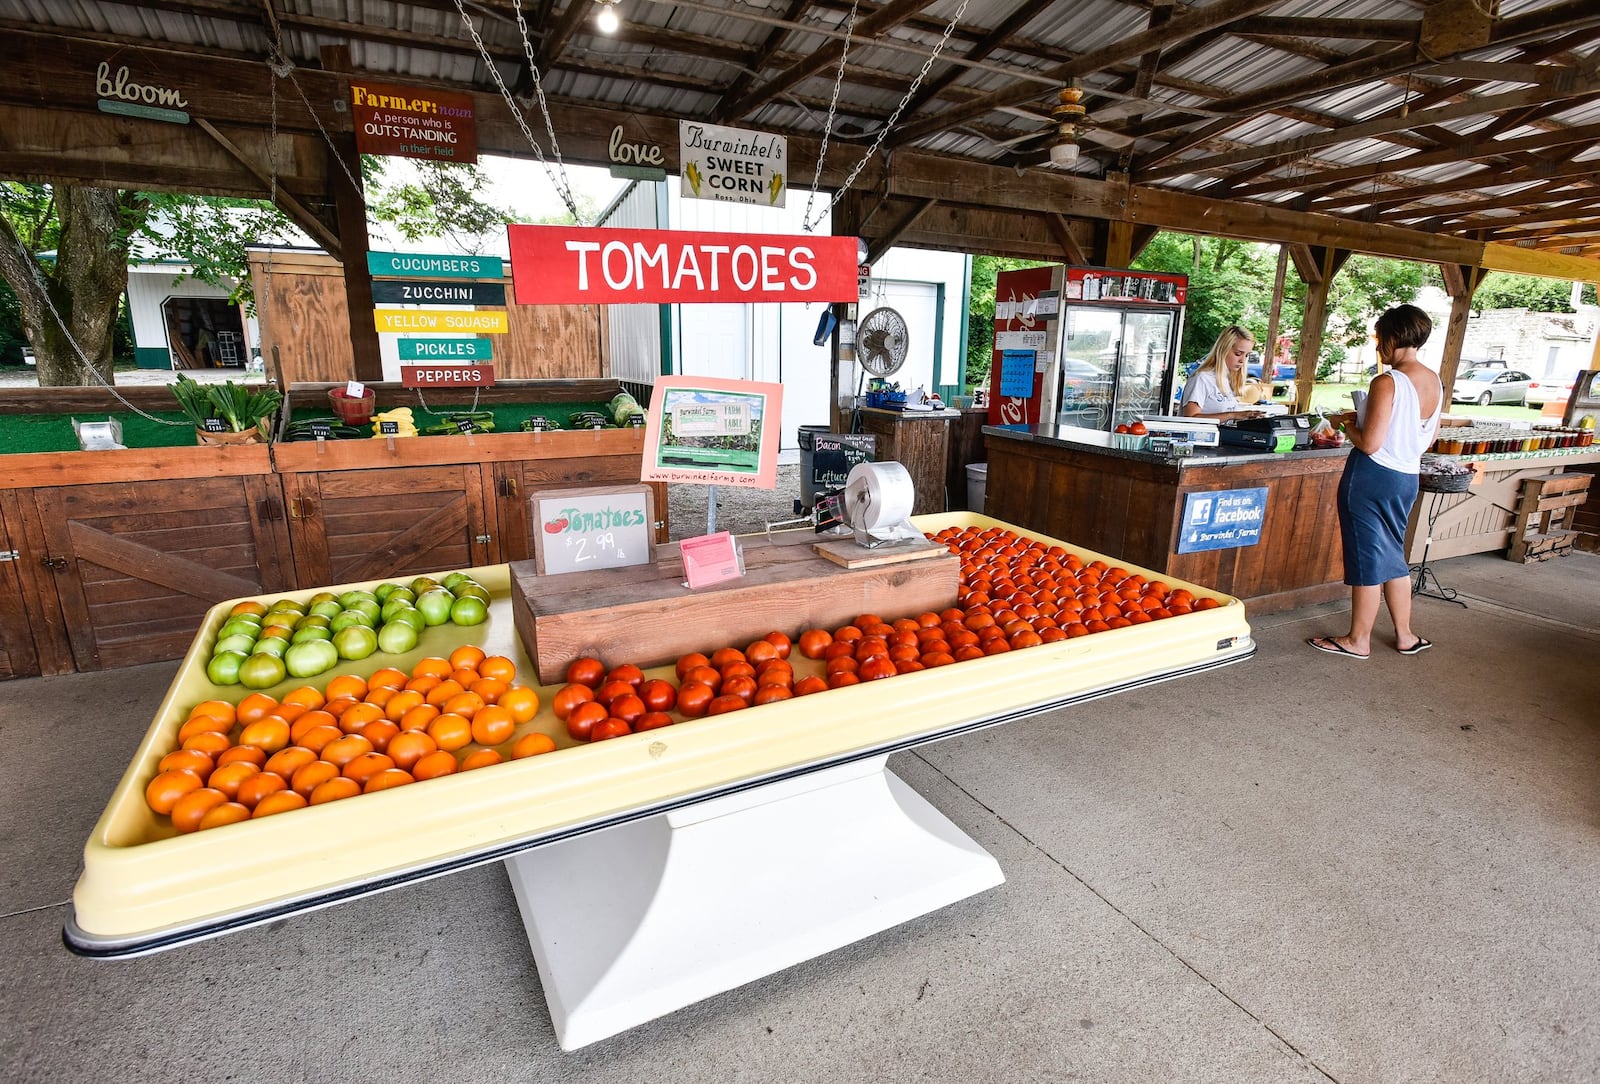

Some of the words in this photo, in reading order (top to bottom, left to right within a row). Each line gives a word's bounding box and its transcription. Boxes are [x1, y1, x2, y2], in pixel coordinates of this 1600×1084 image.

[96, 61, 188, 107] bloom
[350, 85, 438, 114] Farm.er:
[439, 104, 473, 118] noun
[373, 112, 382, 121] A
[384, 114, 420, 126] person
[421, 117, 442, 129] who
[444, 120, 452, 130] is
[364, 122, 457, 144] OUTSTANDING
[400, 143, 409, 152] in
[410, 144, 432, 155] their
[434, 146, 454, 157] field
[608, 125, 665, 165] love
[685, 125, 782, 160] Burwinkel's
[706, 156, 764, 177] SWEET
[708, 174, 764, 194] CORN
[739, 195, 756, 204] Ohio
[391, 257, 481, 273] CUCUMBERS
[565, 240, 818, 292] TOMATOES
[402, 286, 473, 300] ZUCCHINI
[384, 315, 437, 328] YELLOW
[445, 316, 499, 329] SQUASH
[415, 343, 476, 356] PICKLES
[416, 370, 482, 383] PEPPERS
[815, 437, 842, 452] Bacon
[814, 469, 848, 483] Lettuce
[1218, 498, 1232, 507] Find
[559, 506, 645, 534] Tomatoes
[1216, 506, 1261, 523] facebook
[1200, 529, 1236, 541] Burwinkel
[1236, 528, 1259, 539] Farms
